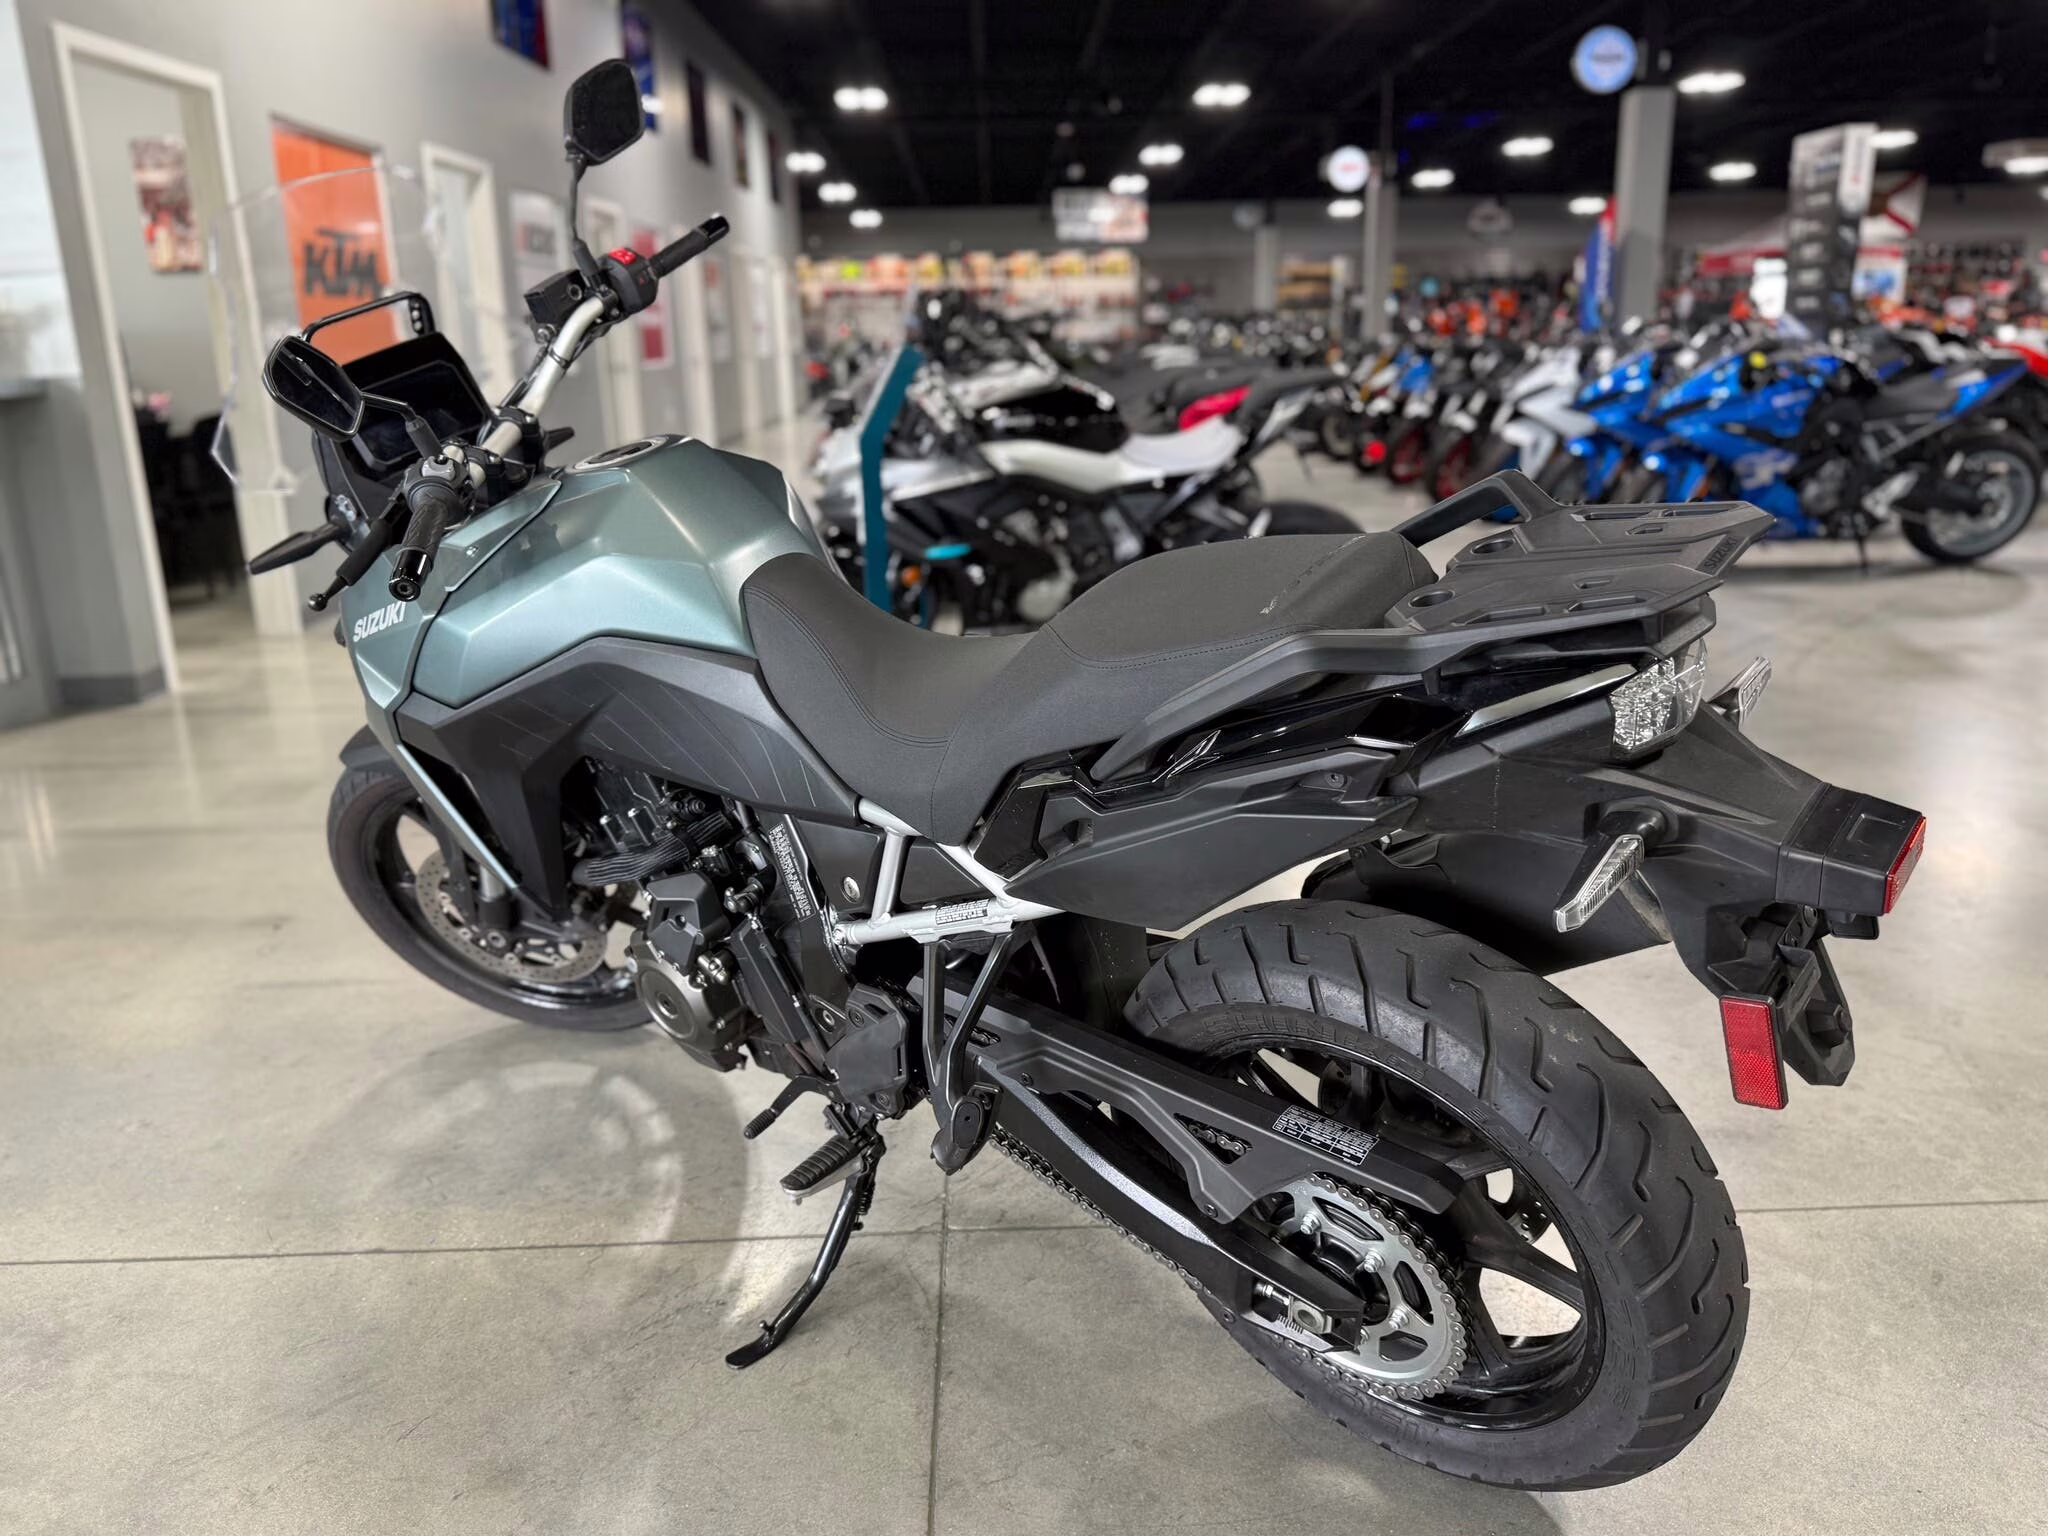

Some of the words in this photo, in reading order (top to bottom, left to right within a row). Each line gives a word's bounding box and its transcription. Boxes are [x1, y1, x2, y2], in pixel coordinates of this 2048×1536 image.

[304, 228, 382, 299] KTM
[1703, 536, 1738, 569] SUZUKI
[353, 600, 407, 642] SUZUKI
